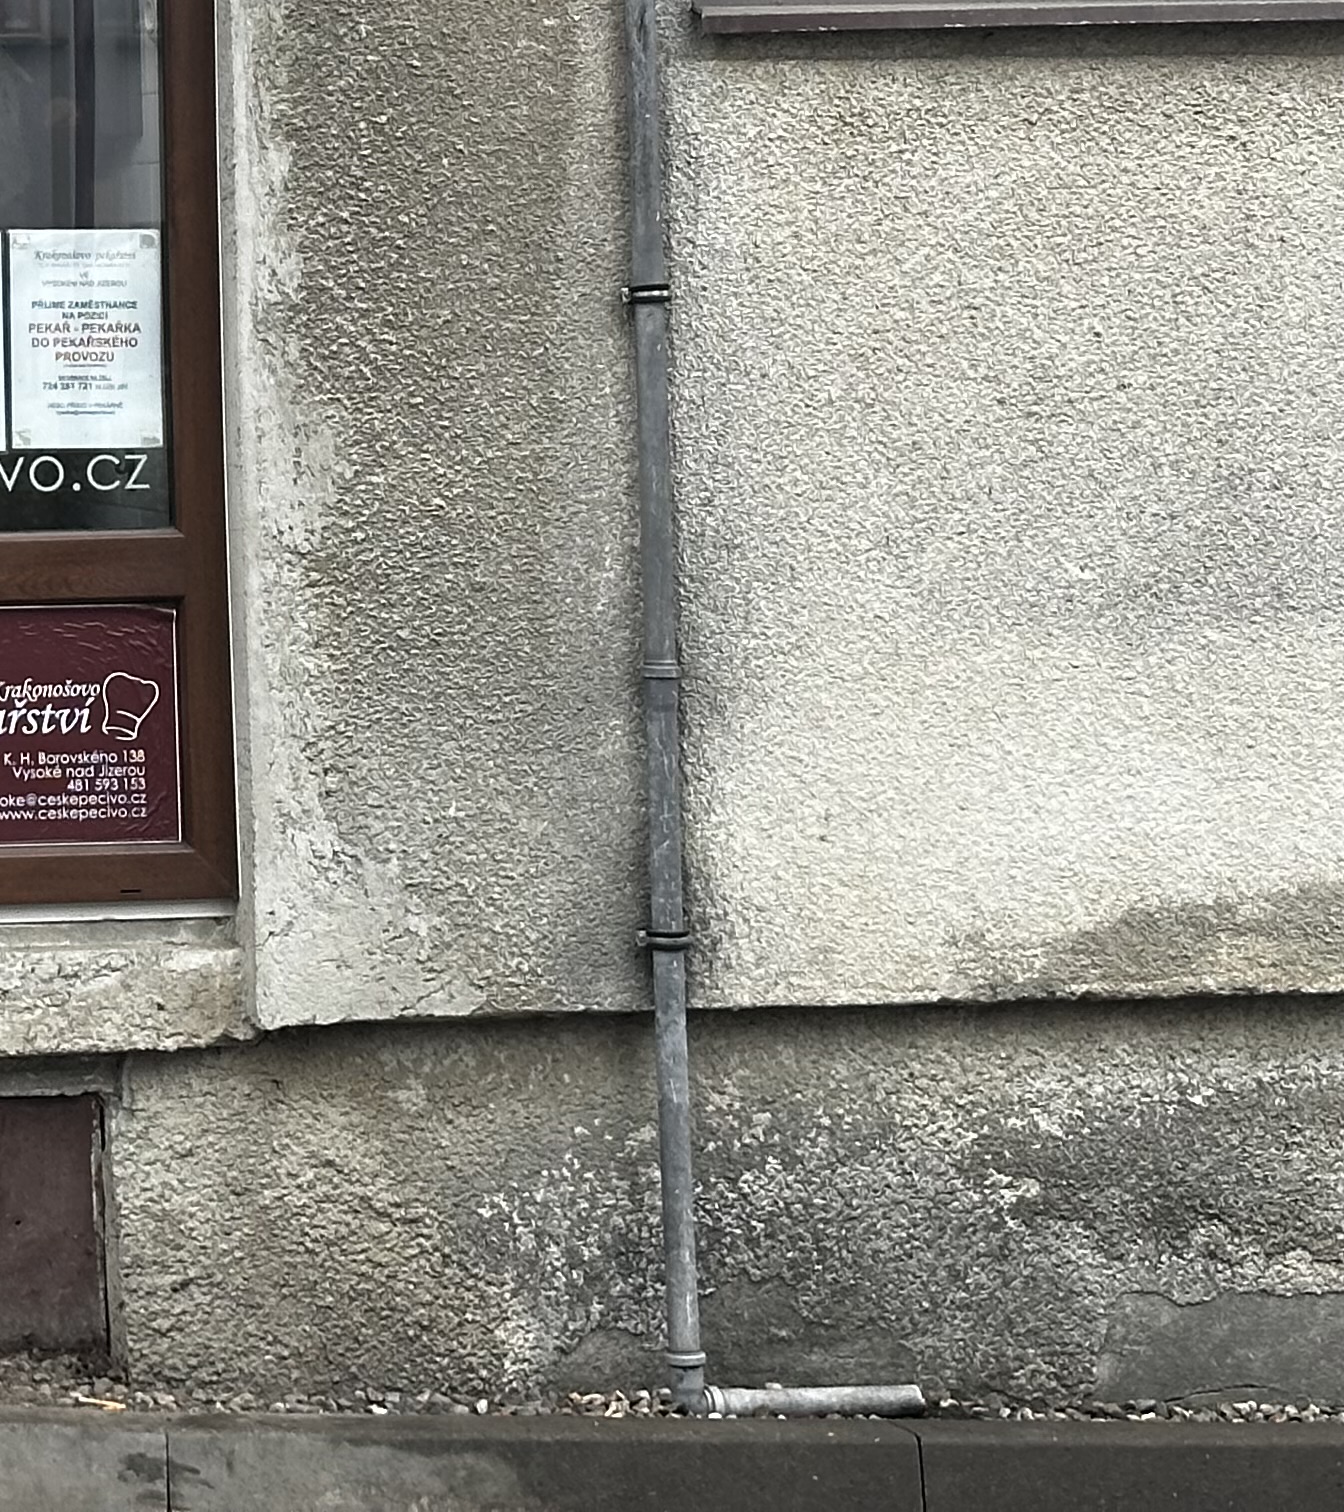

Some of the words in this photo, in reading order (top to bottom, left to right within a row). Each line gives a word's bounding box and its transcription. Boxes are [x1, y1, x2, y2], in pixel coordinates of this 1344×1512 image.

[62, 311, 75, 320] NA
[28, 320, 70, 334] PEKAŘ
[82, 320, 142, 334] PEKAŘKA
[32, 337, 49, 348] DO
[53, 335, 138, 348] PEKAŘSKÉHO
[55, 351, 115, 362] PROVOZU
[38, 750, 118, 765] Borovského
[122, 749, 146, 763] 138
[12, 765, 62, 781] Vysoké
[66, 765, 94, 778] nad
[98, 763, 146, 778] Jizerou
[67, 779, 89, 792] 481
[95, 778, 118, 791] 593
[123, 778, 146, 791] 153
